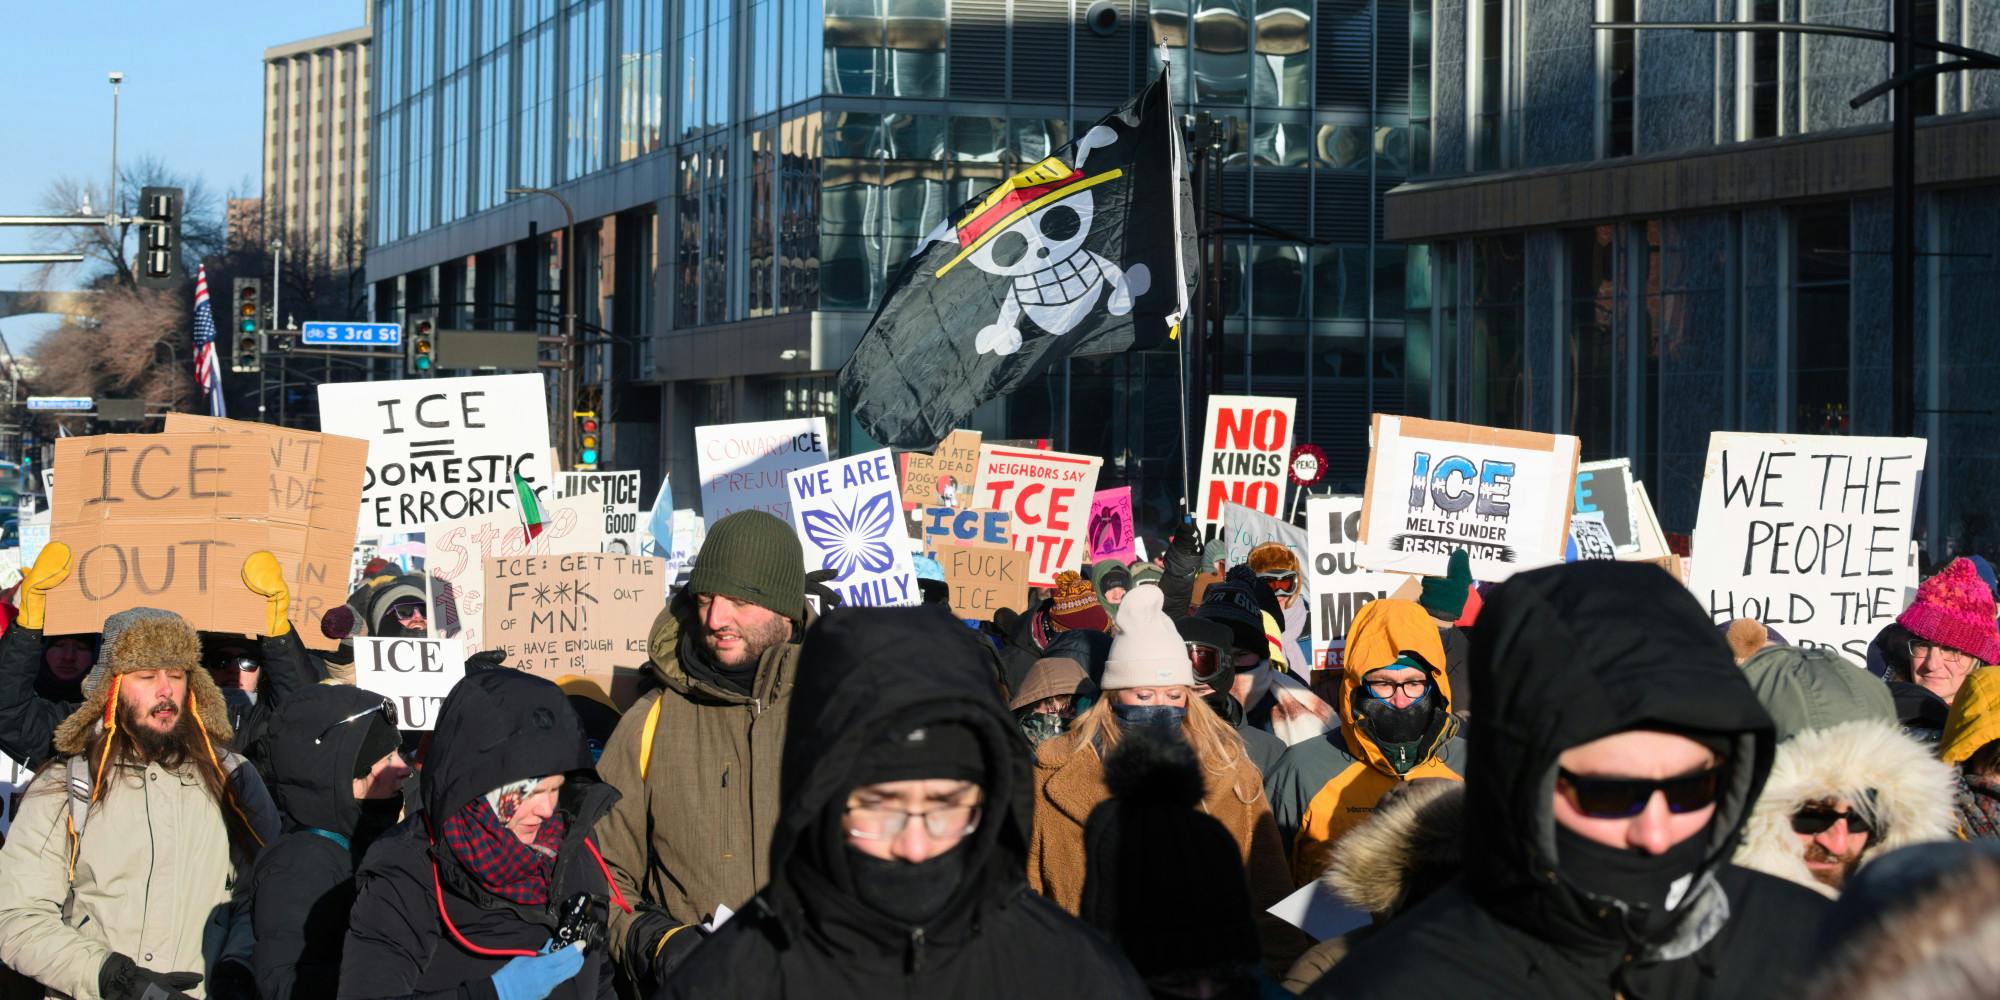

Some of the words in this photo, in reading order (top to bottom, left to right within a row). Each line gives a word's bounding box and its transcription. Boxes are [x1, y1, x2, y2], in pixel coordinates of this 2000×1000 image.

[326, 327, 338, 339] S
[344, 327, 372, 340] 3rd
[378, 328, 397, 340] St
[377, 391, 486, 434] ICE
[1214, 407, 1288, 452] NO
[909, 457, 934, 470] HER
[939, 459, 973, 473] DEAD
[951, 447, 975, 461] ATE
[1211, 452, 1283, 477] KINGS
[84, 444, 232, 506] ICE
[794, 469, 833, 500] WE
[843, 455, 890, 489] ARE
[988, 463, 1060, 480] NEIGHBORS
[1062, 470, 1086, 482] SAY
[1408, 452, 1516, 522] ICE
[1722, 449, 1796, 509] WE
[1810, 454, 1913, 515] THE
[556, 474, 638, 505] JUSTICE
[904, 483, 931, 497] ASS
[1206, 480, 1279, 521] NO
[986, 480, 1076, 531] ICE
[605, 513, 637, 534] GOOD
[925, 506, 1010, 544] ICE
[1233, 519, 1259, 549] YOU
[1328, 509, 1363, 545] IC
[1406, 517, 1455, 535] MELTS
[1459, 523, 1507, 541] UNDER
[1011, 533, 1075, 580] UT!
[1315, 551, 1366, 576] OU
[1402, 537, 1504, 561] RESISTANCE
[1742, 521, 1900, 578] PEOPLE
[77, 539, 236, 601] OUT
[495, 558, 548, 579] ICE:
[560, 556, 604, 572] GET
[613, 557, 654, 575] THE
[953, 551, 1014, 582] FUCK
[613, 588, 645, 602] OUT
[833, 573, 910, 608] AMILY
[955, 586, 997, 610] ICE
[1710, 588, 1815, 625] HOLD
[1830, 587, 1897, 625] THE
[500, 618, 517, 631] OF
[530, 606, 589, 634] MN!
[368, 639, 445, 673] ICE
[496, 644, 516, 657] WE
[523, 640, 558, 655] HAVE
[564, 639, 614, 653] ENOUGH
[626, 639, 647, 652] ICE
[516, 659, 533, 671] AS
[544, 657, 560, 669] IT
[570, 655, 585, 669] IS!
